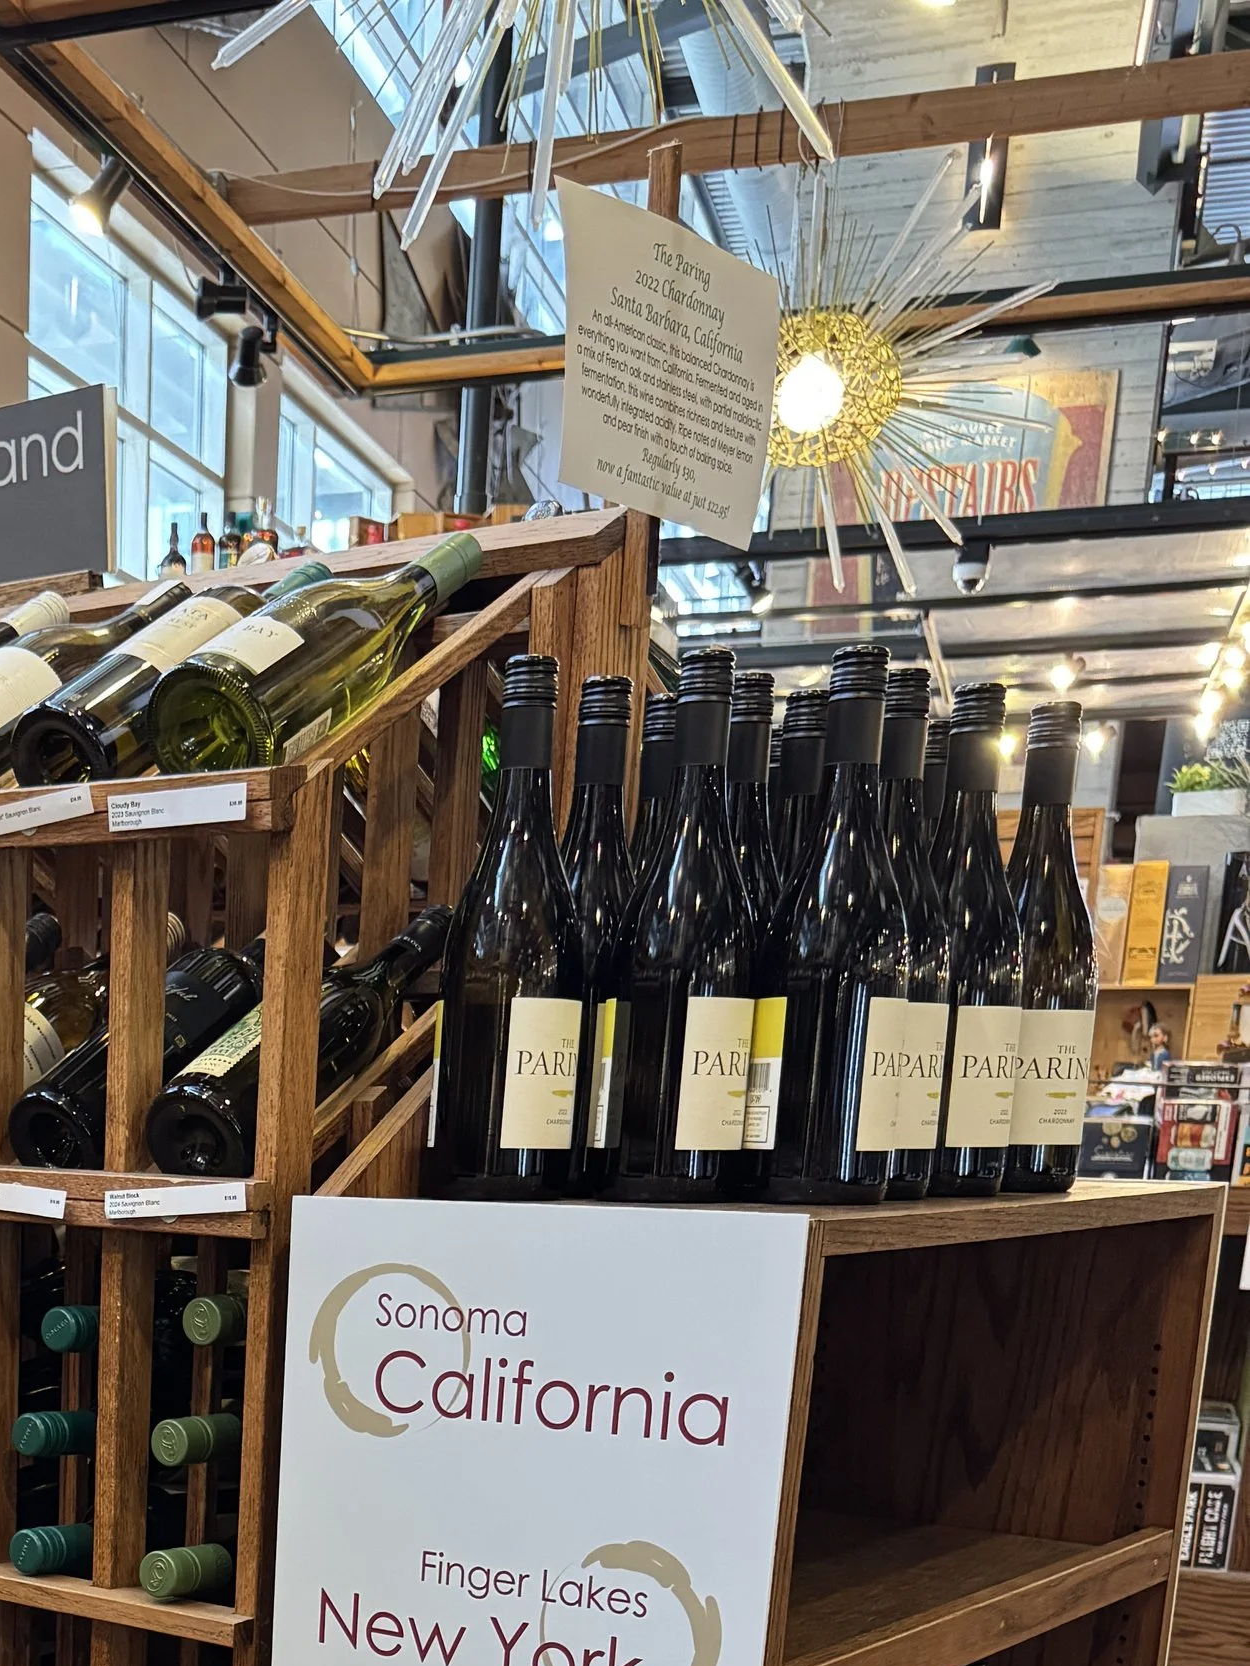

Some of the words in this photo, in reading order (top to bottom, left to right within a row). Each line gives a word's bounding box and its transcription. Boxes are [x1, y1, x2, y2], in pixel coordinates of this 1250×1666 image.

[653, 242, 673, 267] The
[675, 253, 711, 293] Paring
[635, 269, 660, 293] 2022
[662, 279, 725, 330] Chardonnay
[610, 286, 643, 318] Santa
[645, 303, 691, 343] Barbara,
[693, 326, 744, 364] California
[577, 324, 616, 352] everything
[616, 340, 630, 355] you
[629, 347, 647, 363] want
[647, 351, 662, 370] from
[662, 359, 695, 384] California.
[695, 373, 729, 399] Fermented
[728, 390, 742, 404] and
[741, 396, 758, 412] aged
[758, 400, 764, 414] in
[592, 308, 603, 324] An
[603, 314, 646, 342] all-American
[646, 333, 669, 356] classic,
[669, 342, 681, 360] this
[681, 348, 713, 373] balanced
[713, 362, 750, 392] Chardonnay
[749, 378, 755, 392] is
[576, 343, 583, 355] a
[583, 345, 596, 361] mix
[597, 350, 605, 363] of
[605, 352, 629, 375] French
[629, 366, 642, 381] oak
[642, 372, 656, 387] and
[656, 376, 682, 398] stainless
[682, 387, 699, 406] steel,
[699, 395, 713, 410] with
[712, 402, 733, 418] partial
[732, 410, 763, 432] malolactic
[581, 385, 621, 412] wonderfully
[620, 398, 654, 424] integrated
[654, 415, 677, 436] acidity.
[677, 422, 693, 440] Ripe
[692, 430, 710, 447] notes
[710, 437, 718, 449] of
[717, 439, 736, 457] Meyer
[735, 446, 754, 465] lemon
[627, 381, 639, 398] this
[639, 389, 655, 405] wine
[654, 396, 686, 418] combines
[686, 407, 710, 429] richness
[710, 420, 724, 434] and
[723, 424, 744, 443] texture
[744, 433, 757, 448] with
[602, 413, 617, 428] and
[617, 419, 634, 435] pear
[633, 422, 650, 441] finish
[650, 431, 664, 447] with
[663, 438, 670, 449] a
[669, 437, 688, 457] touch
[688, 446, 697, 459] of
[696, 450, 717, 471] baking
[716, 458, 734, 475] spice.
[960, 434, 1017, 449] MARKET
[596, 458, 617, 476] now
[616, 465, 624, 478] a
[621, 463, 661, 492] fantastic
[660, 480, 682, 501] value
[682, 489, 692, 504] at
[690, 491, 707, 511] just
[641, 447, 681, 480] Regularly
[681, 465, 696, 483] $30,
[880, 457, 1040, 523] UPSTAIRS
[4, 809, 29, 821] Sauvignon
[28, 805, 42, 814] Blanc
[110, 801, 130, 810] Cloudy
[130, 800, 141, 809] Bay
[111, 818, 143, 828] Marlborough
[124, 808, 151, 818] Sauvignon
[150, 807, 165, 816] Blanc
[561, 1038, 575, 1049] THE
[737, 1038, 749, 1049] THE
[1057, 1044, 1077, 1055] THE
[1038, 1117, 1075, 1125] CHARDONNAY
[108, 1208, 136, 1216] Marlborough
[121, 1200, 145, 1209] Sauvignon
[145, 1199, 160, 1207] Blanc
[375, 1293, 528, 1339] Sonoma
[374, 1349, 729, 1447] California
[1204, 1489, 1224, 1524] CASE
[1198, 1522, 1218, 1565] FLIGHT
[421, 1550, 530, 1599] Finger
[541, 1569, 649, 1619] Lakes
